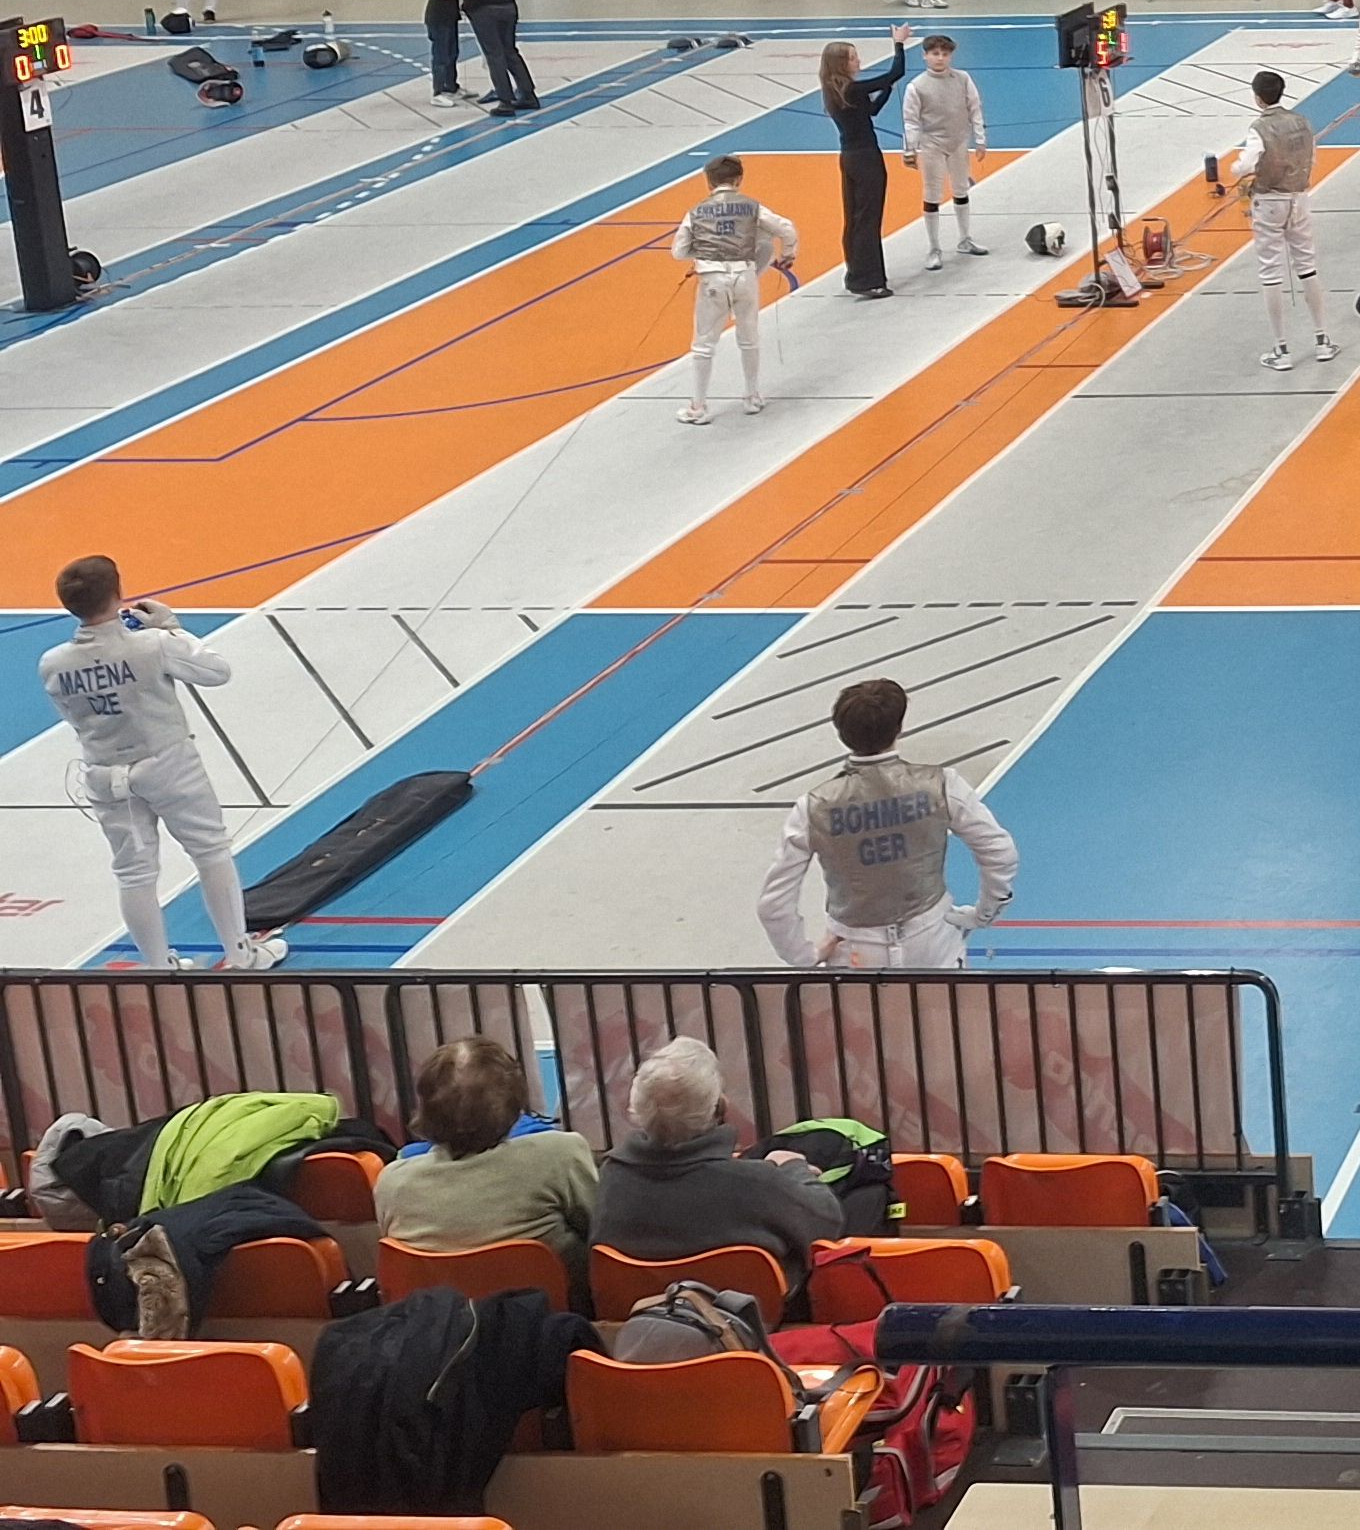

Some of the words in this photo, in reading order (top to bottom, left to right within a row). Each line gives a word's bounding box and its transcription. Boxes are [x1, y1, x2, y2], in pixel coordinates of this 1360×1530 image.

[17, 24, 49, 49] 3:00
[15, 55, 31, 81] 0
[55, 44, 71, 69] 0
[30, 90, 45, 119] 4
[1098, 77, 1111, 108] 6
[58, 658, 138, 696] MATĚNA
[87, 692, 123, 716] CZE
[858, 832, 909, 867] GER
